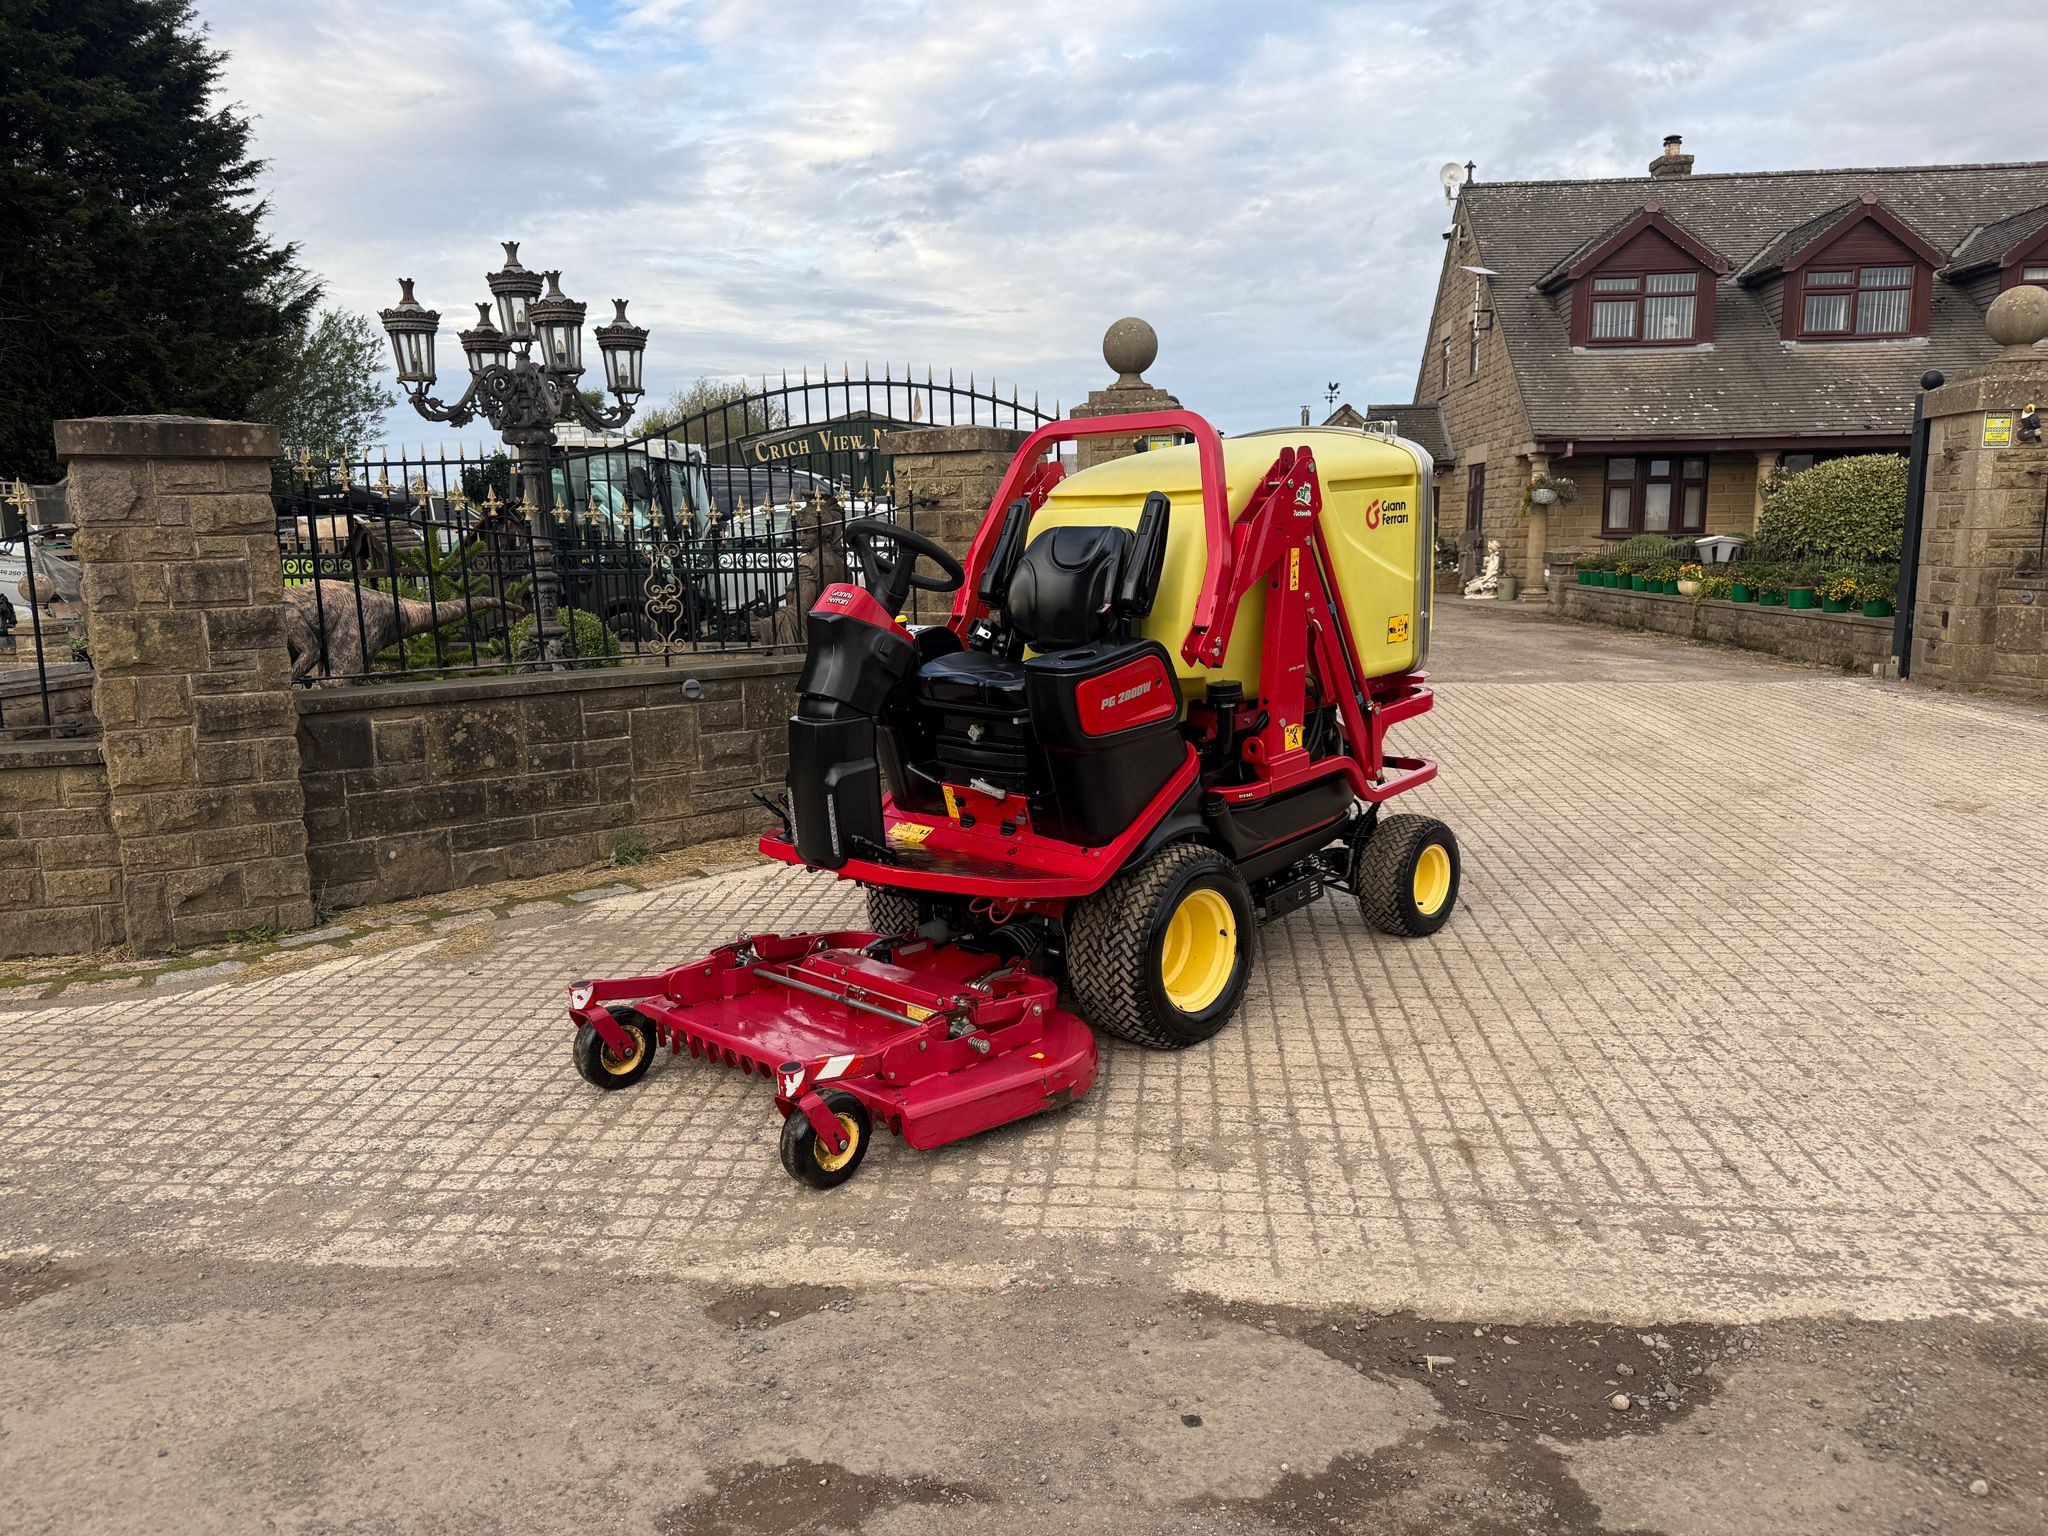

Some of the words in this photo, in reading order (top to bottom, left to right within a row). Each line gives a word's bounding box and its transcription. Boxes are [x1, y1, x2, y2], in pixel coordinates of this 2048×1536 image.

[755, 440, 810, 462] CRICH
[818, 430, 863, 451] VIEW
[1382, 513, 1408, 525] Ferrari
[832, 590, 853, 599] Gianni
[828, 596, 849, 606] Ferrari
[1101, 696, 1116, 710] PG
[1118, 681, 1152, 704] 2800W
